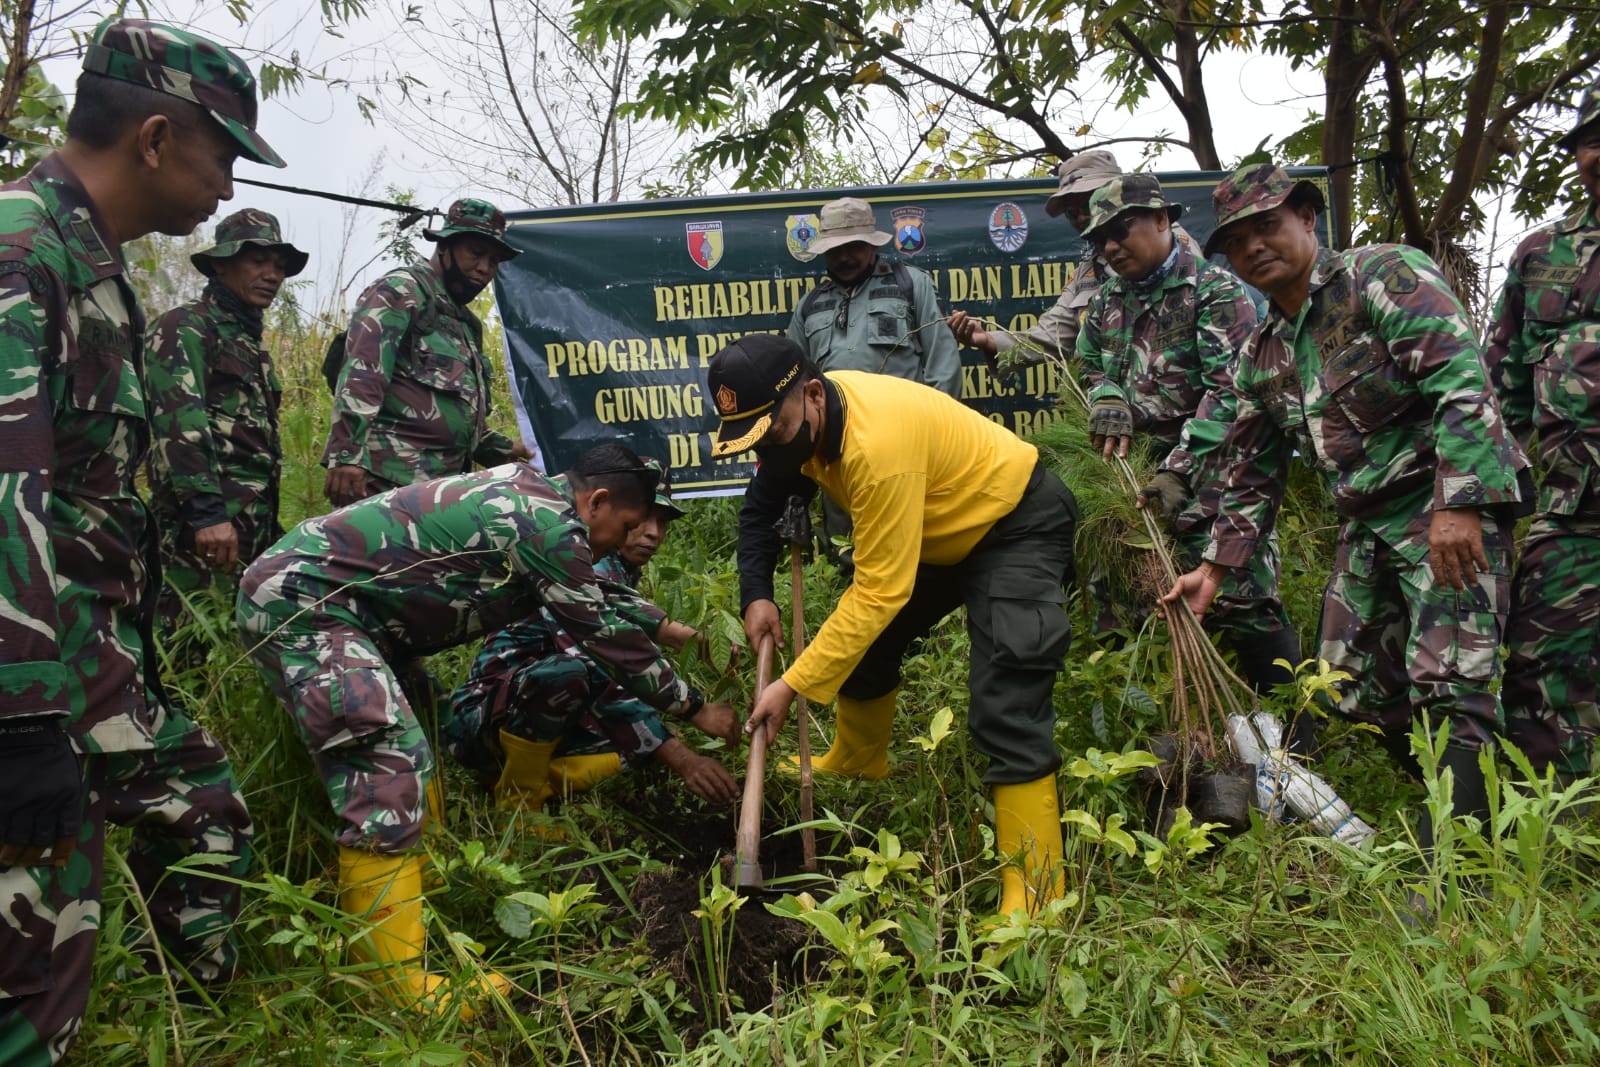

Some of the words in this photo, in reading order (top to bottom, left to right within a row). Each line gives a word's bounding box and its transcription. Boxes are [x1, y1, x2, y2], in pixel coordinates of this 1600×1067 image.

[654, 275, 833, 322] REHABILITA
[948, 265, 1002, 303] DAN
[544, 335, 690, 378] PROGRAM
[1320, 335, 1339, 362] TNI
[774, 363, 801, 392] POLHUT
[595, 383, 703, 424] GUNUNG
[667, 432, 702, 468] DI
